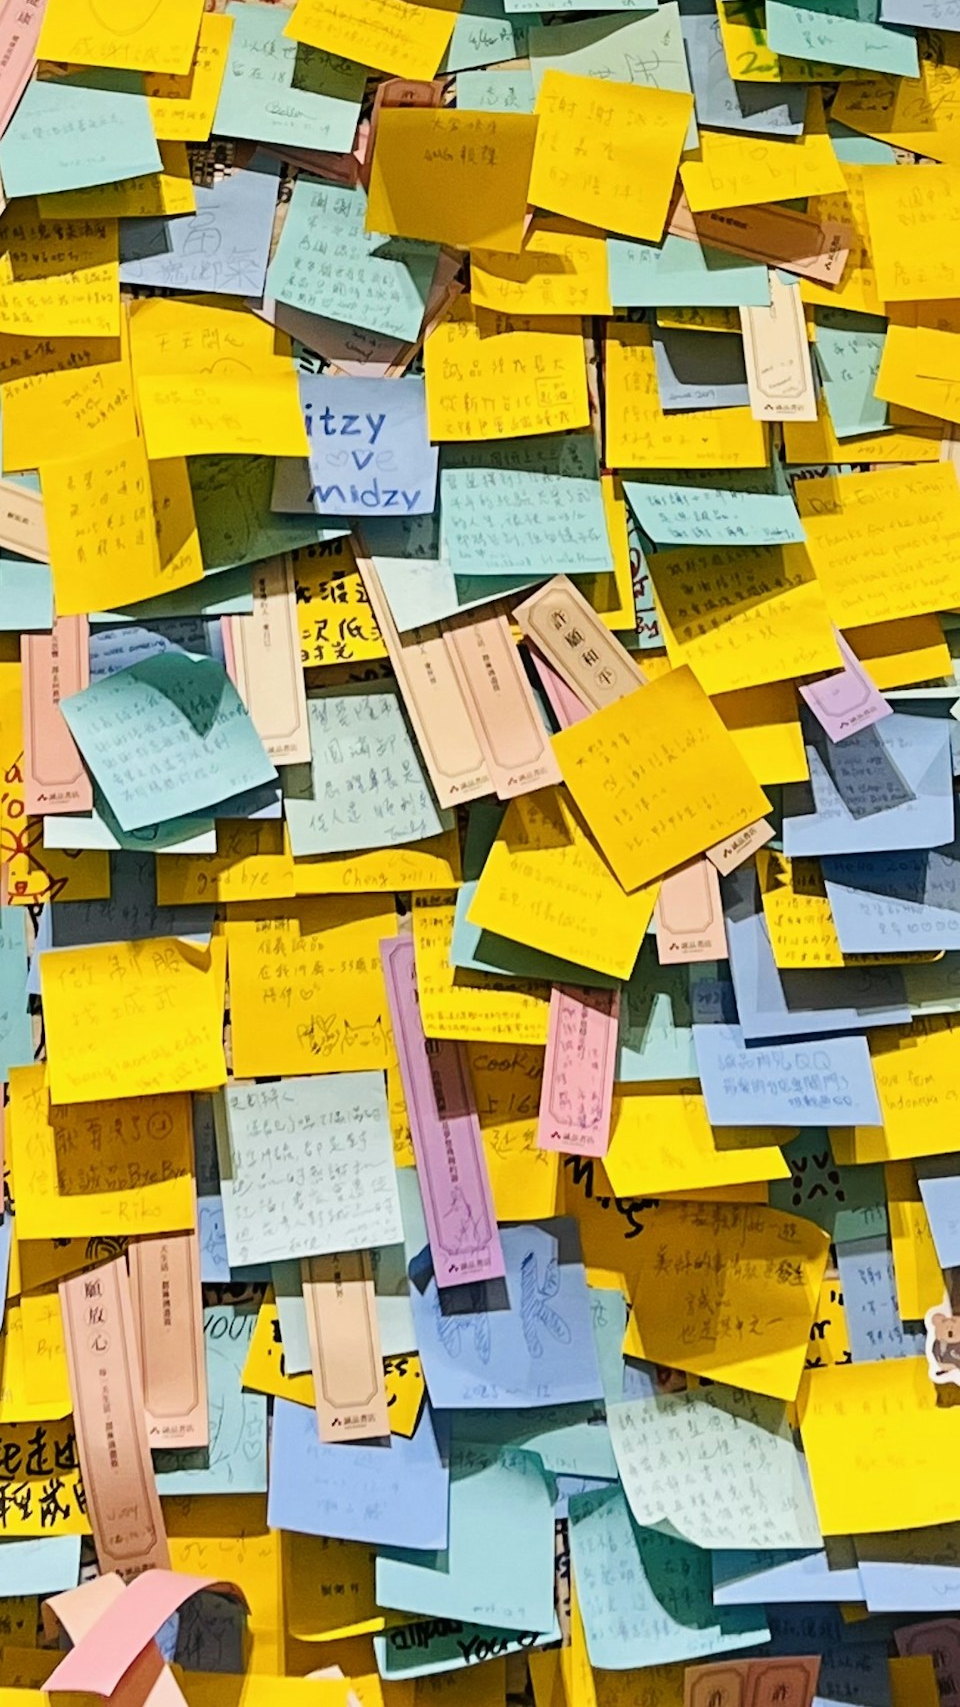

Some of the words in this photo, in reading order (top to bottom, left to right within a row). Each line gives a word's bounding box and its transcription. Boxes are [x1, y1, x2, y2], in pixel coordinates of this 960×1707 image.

[305, 402, 387, 445] itzy
[547, 605, 620, 690] 許願和平
